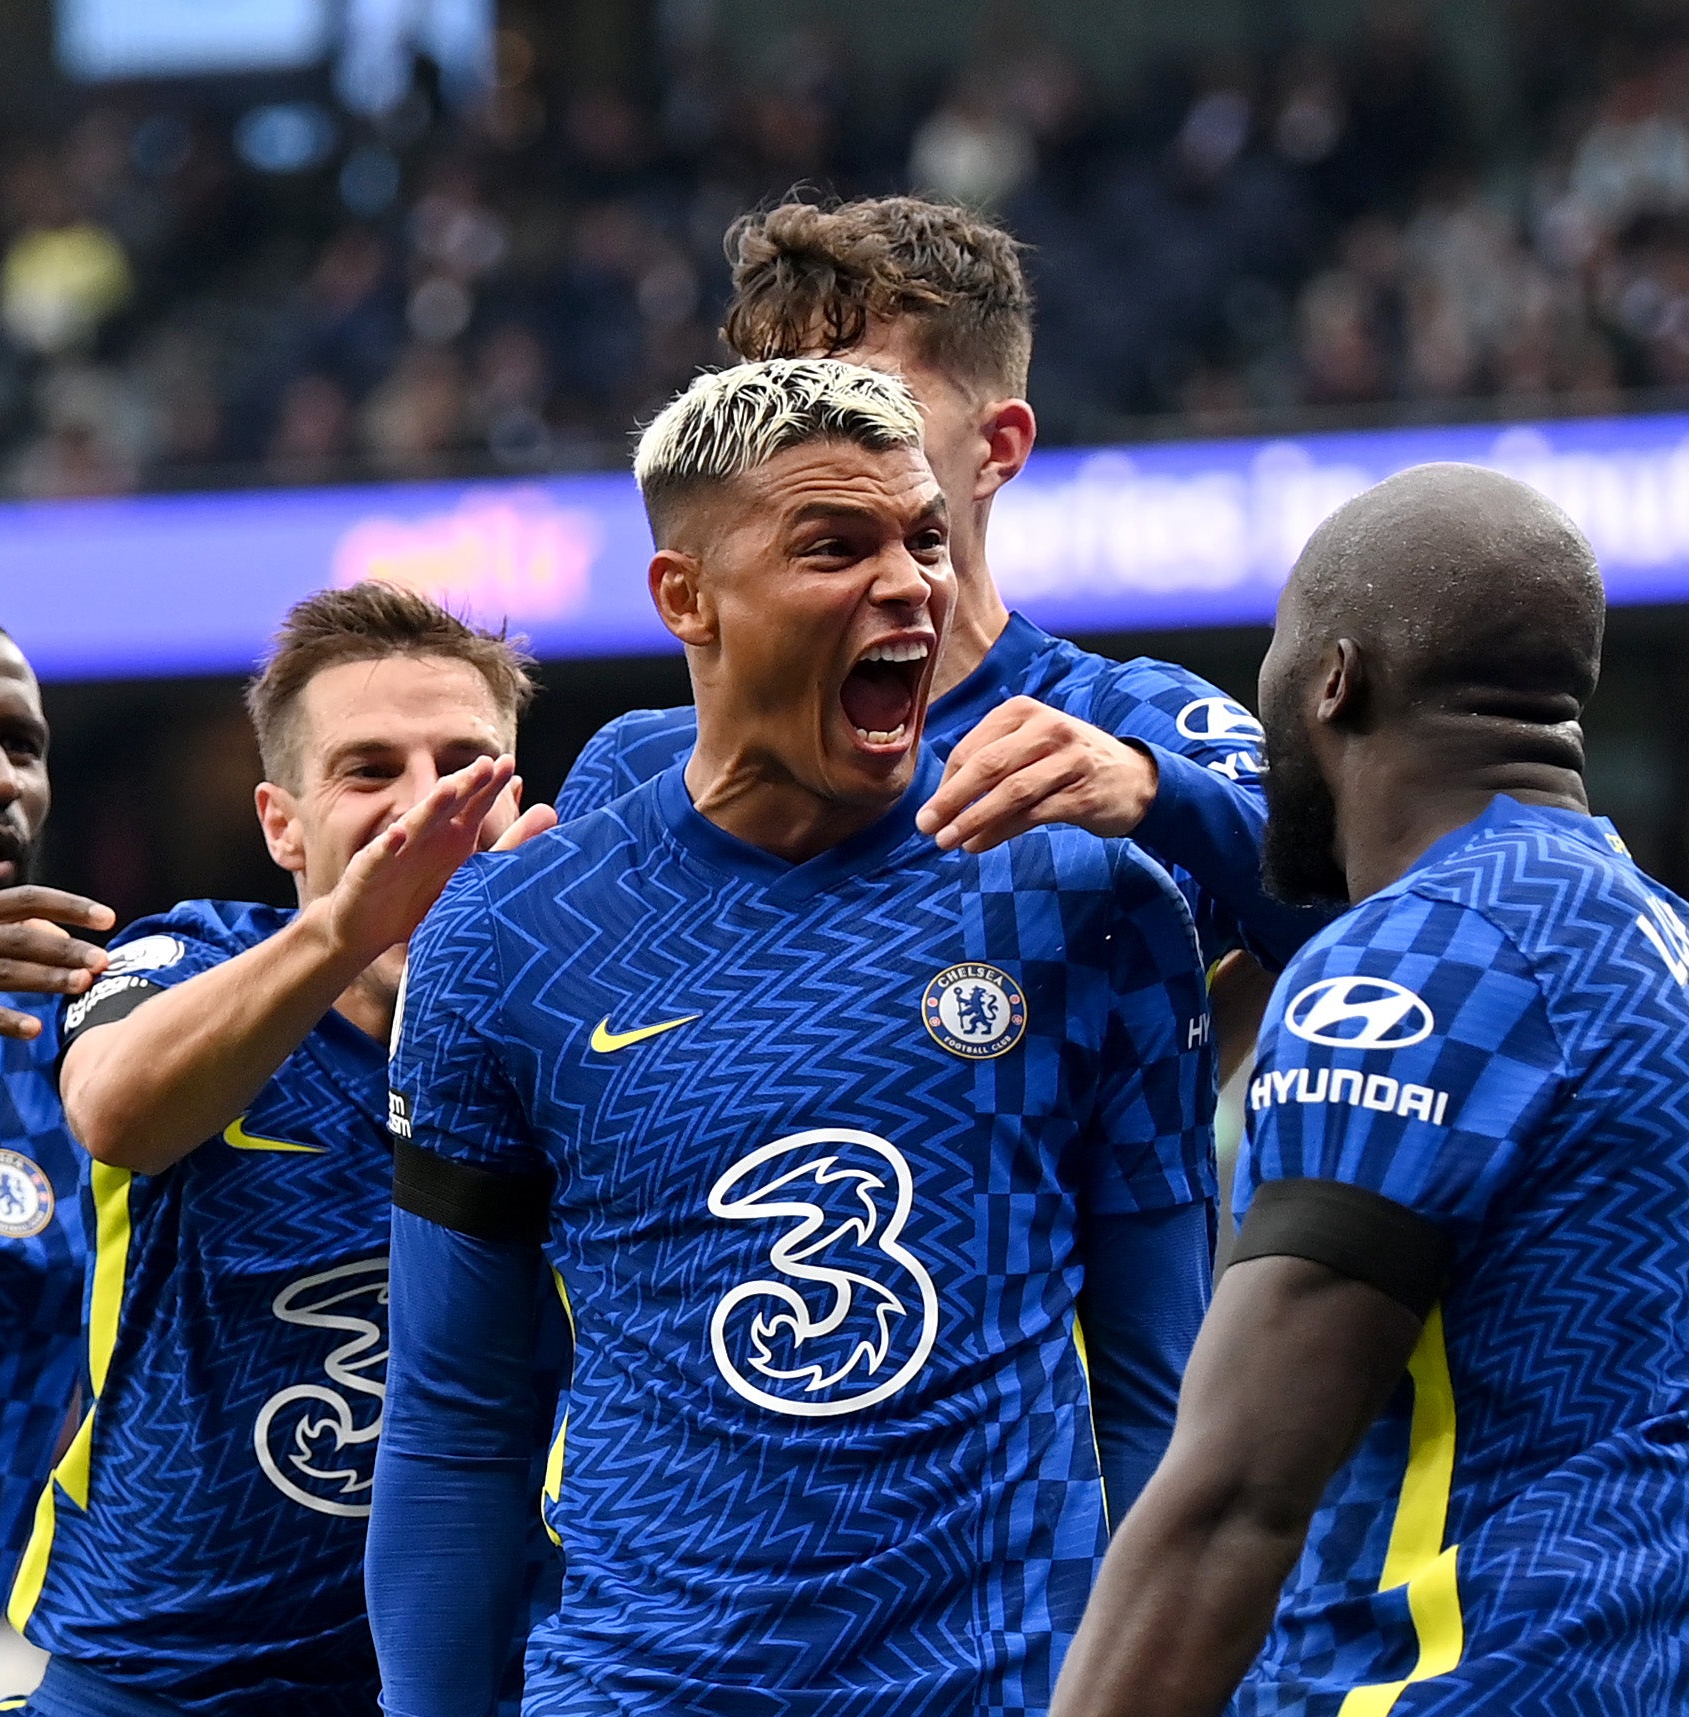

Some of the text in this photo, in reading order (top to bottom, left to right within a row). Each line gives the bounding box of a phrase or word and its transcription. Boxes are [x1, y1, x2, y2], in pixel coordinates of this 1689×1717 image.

[938, 967, 1012, 1054] CHELSEA FOOTBALL CLUB
[1251, 1068, 1449, 1126] HYUNDAI
